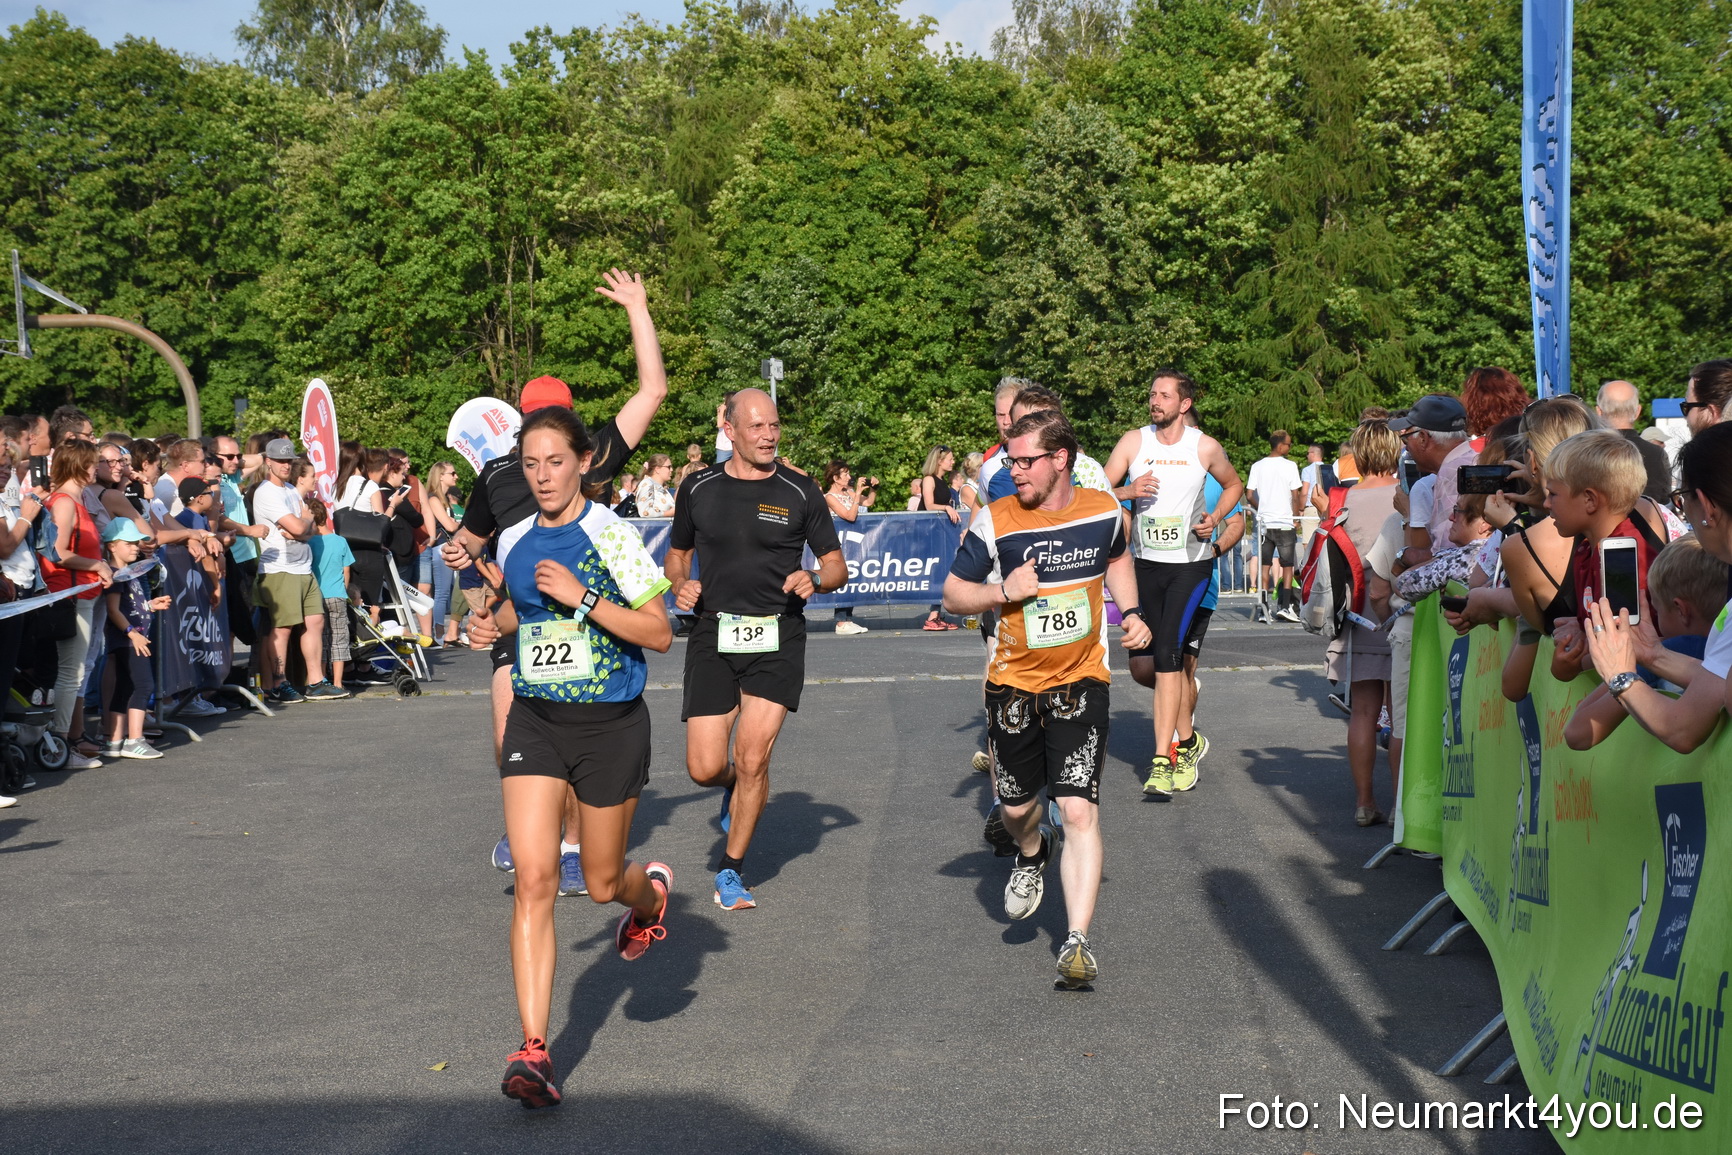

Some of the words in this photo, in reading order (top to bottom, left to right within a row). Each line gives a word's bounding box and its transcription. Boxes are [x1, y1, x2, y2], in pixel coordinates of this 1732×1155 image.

[1155, 459, 1191, 467] KLEBL
[1145, 528, 1179, 541] 1155
[1037, 547, 1100, 565] Fischer
[844, 552, 940, 579] scher
[1043, 559, 1096, 572] AUTOMOBILE
[1037, 610, 1078, 633] 788
[732, 626, 764, 642] 138
[1062, 627, 1083, 636] Andreas
[532, 642, 574, 667] 222
[531, 666, 556, 675] Hollweck
[556, 664, 579, 673] Bettina
[1671, 844, 1699, 878] Fischer
[1594, 1069, 1642, 1114] neumarkt
